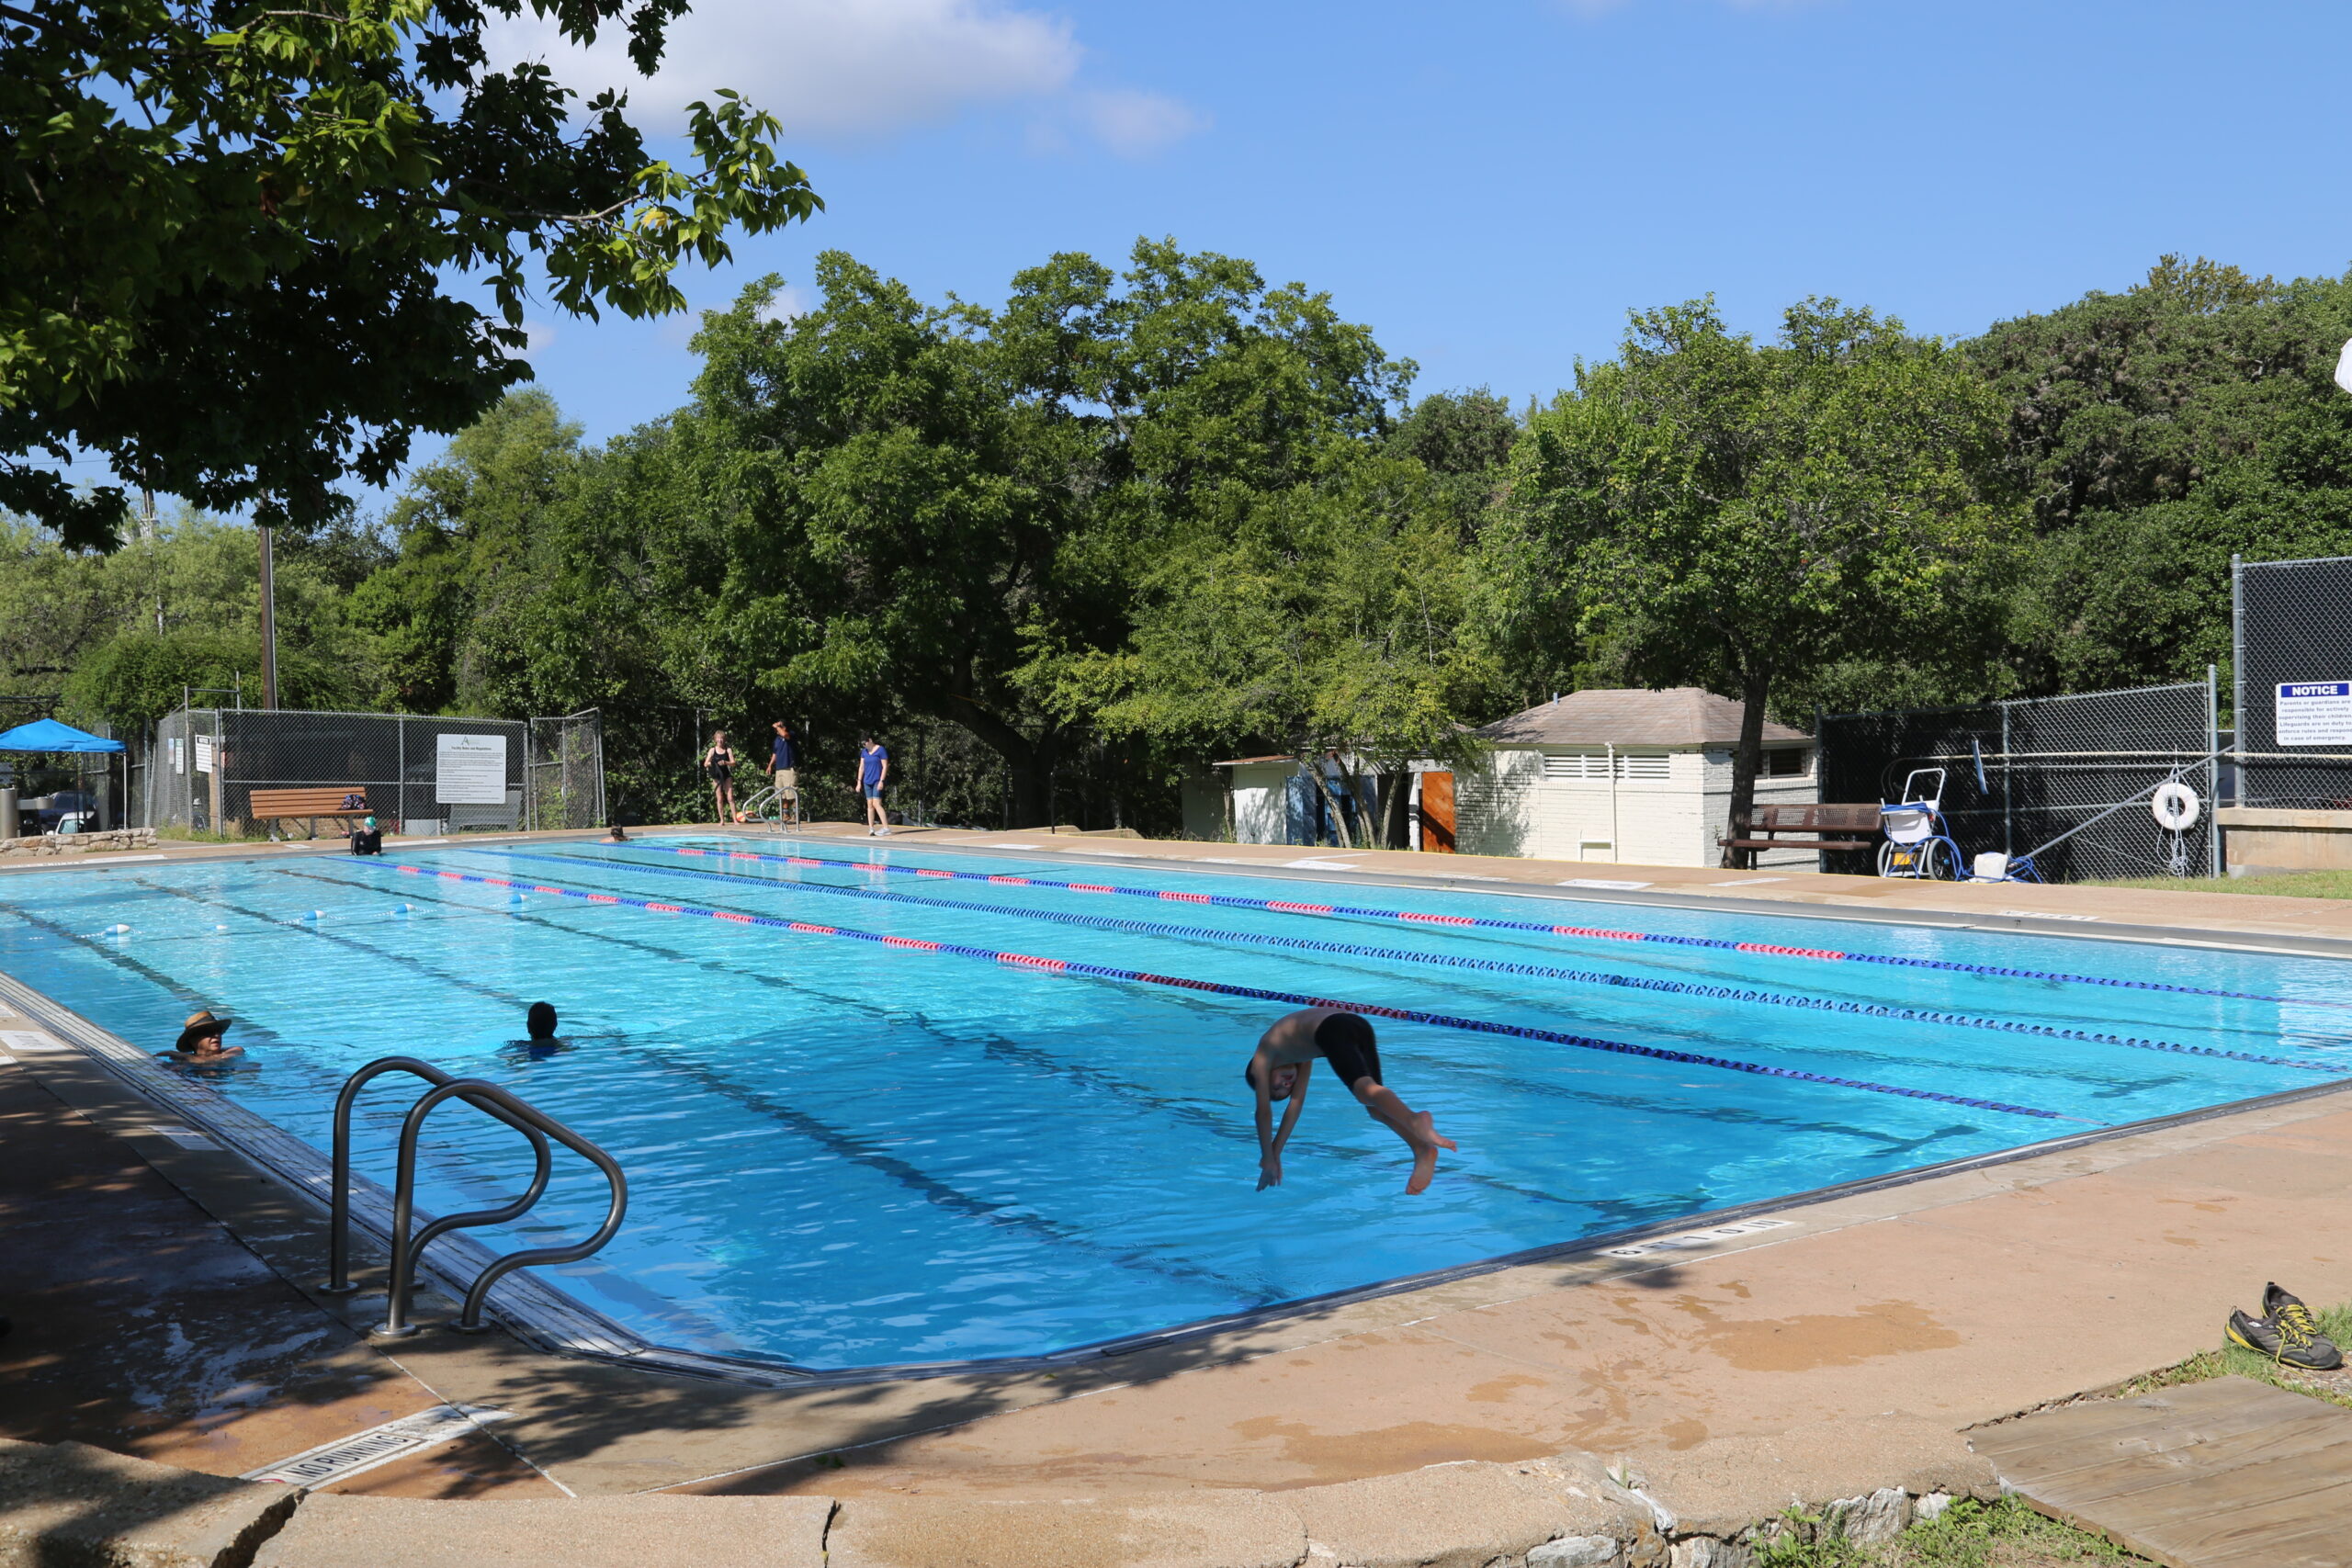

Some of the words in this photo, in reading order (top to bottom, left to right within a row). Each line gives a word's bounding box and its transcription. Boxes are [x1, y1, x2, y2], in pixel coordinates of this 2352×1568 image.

[2292, 685, 2338, 696] NOTICE
[284, 1463, 334, 1478] NO
[313, 1435, 409, 1467] RUNNING
